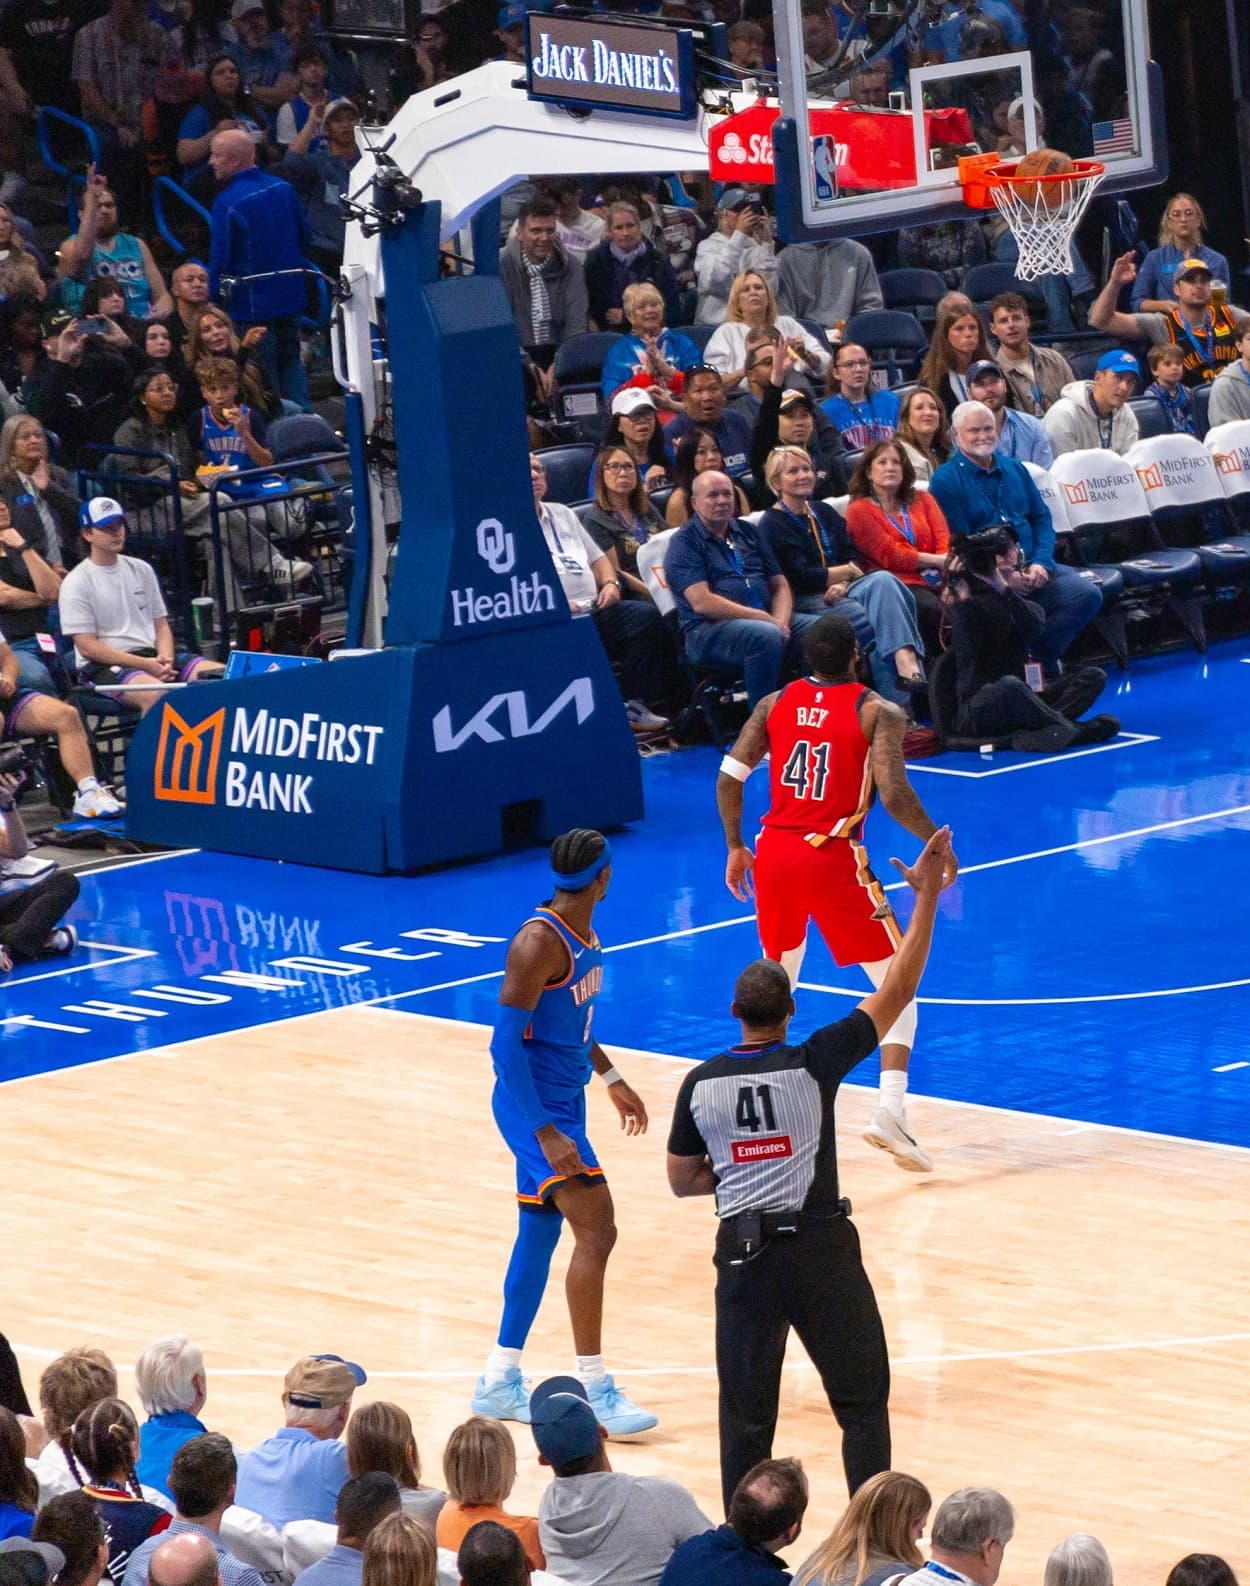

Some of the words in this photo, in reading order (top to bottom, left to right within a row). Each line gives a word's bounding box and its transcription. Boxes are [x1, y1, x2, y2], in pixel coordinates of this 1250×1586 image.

[532, 33, 588, 82] JACK
[592, 39, 677, 93] DANIEL'S
[748, 134, 773, 164] Sta
[1090, 489, 1119, 503] BANK
[1163, 472, 1195, 488] BANK
[450, 571, 557, 627] Health
[796, 706, 830, 729] BEY
[225, 761, 314, 815] BANK
[780, 740, 832, 801] 41
[0, 926, 508, 1035] THUNDER
[735, 1083, 777, 1133] 41
[736, 1142, 787, 1158] Emirates
